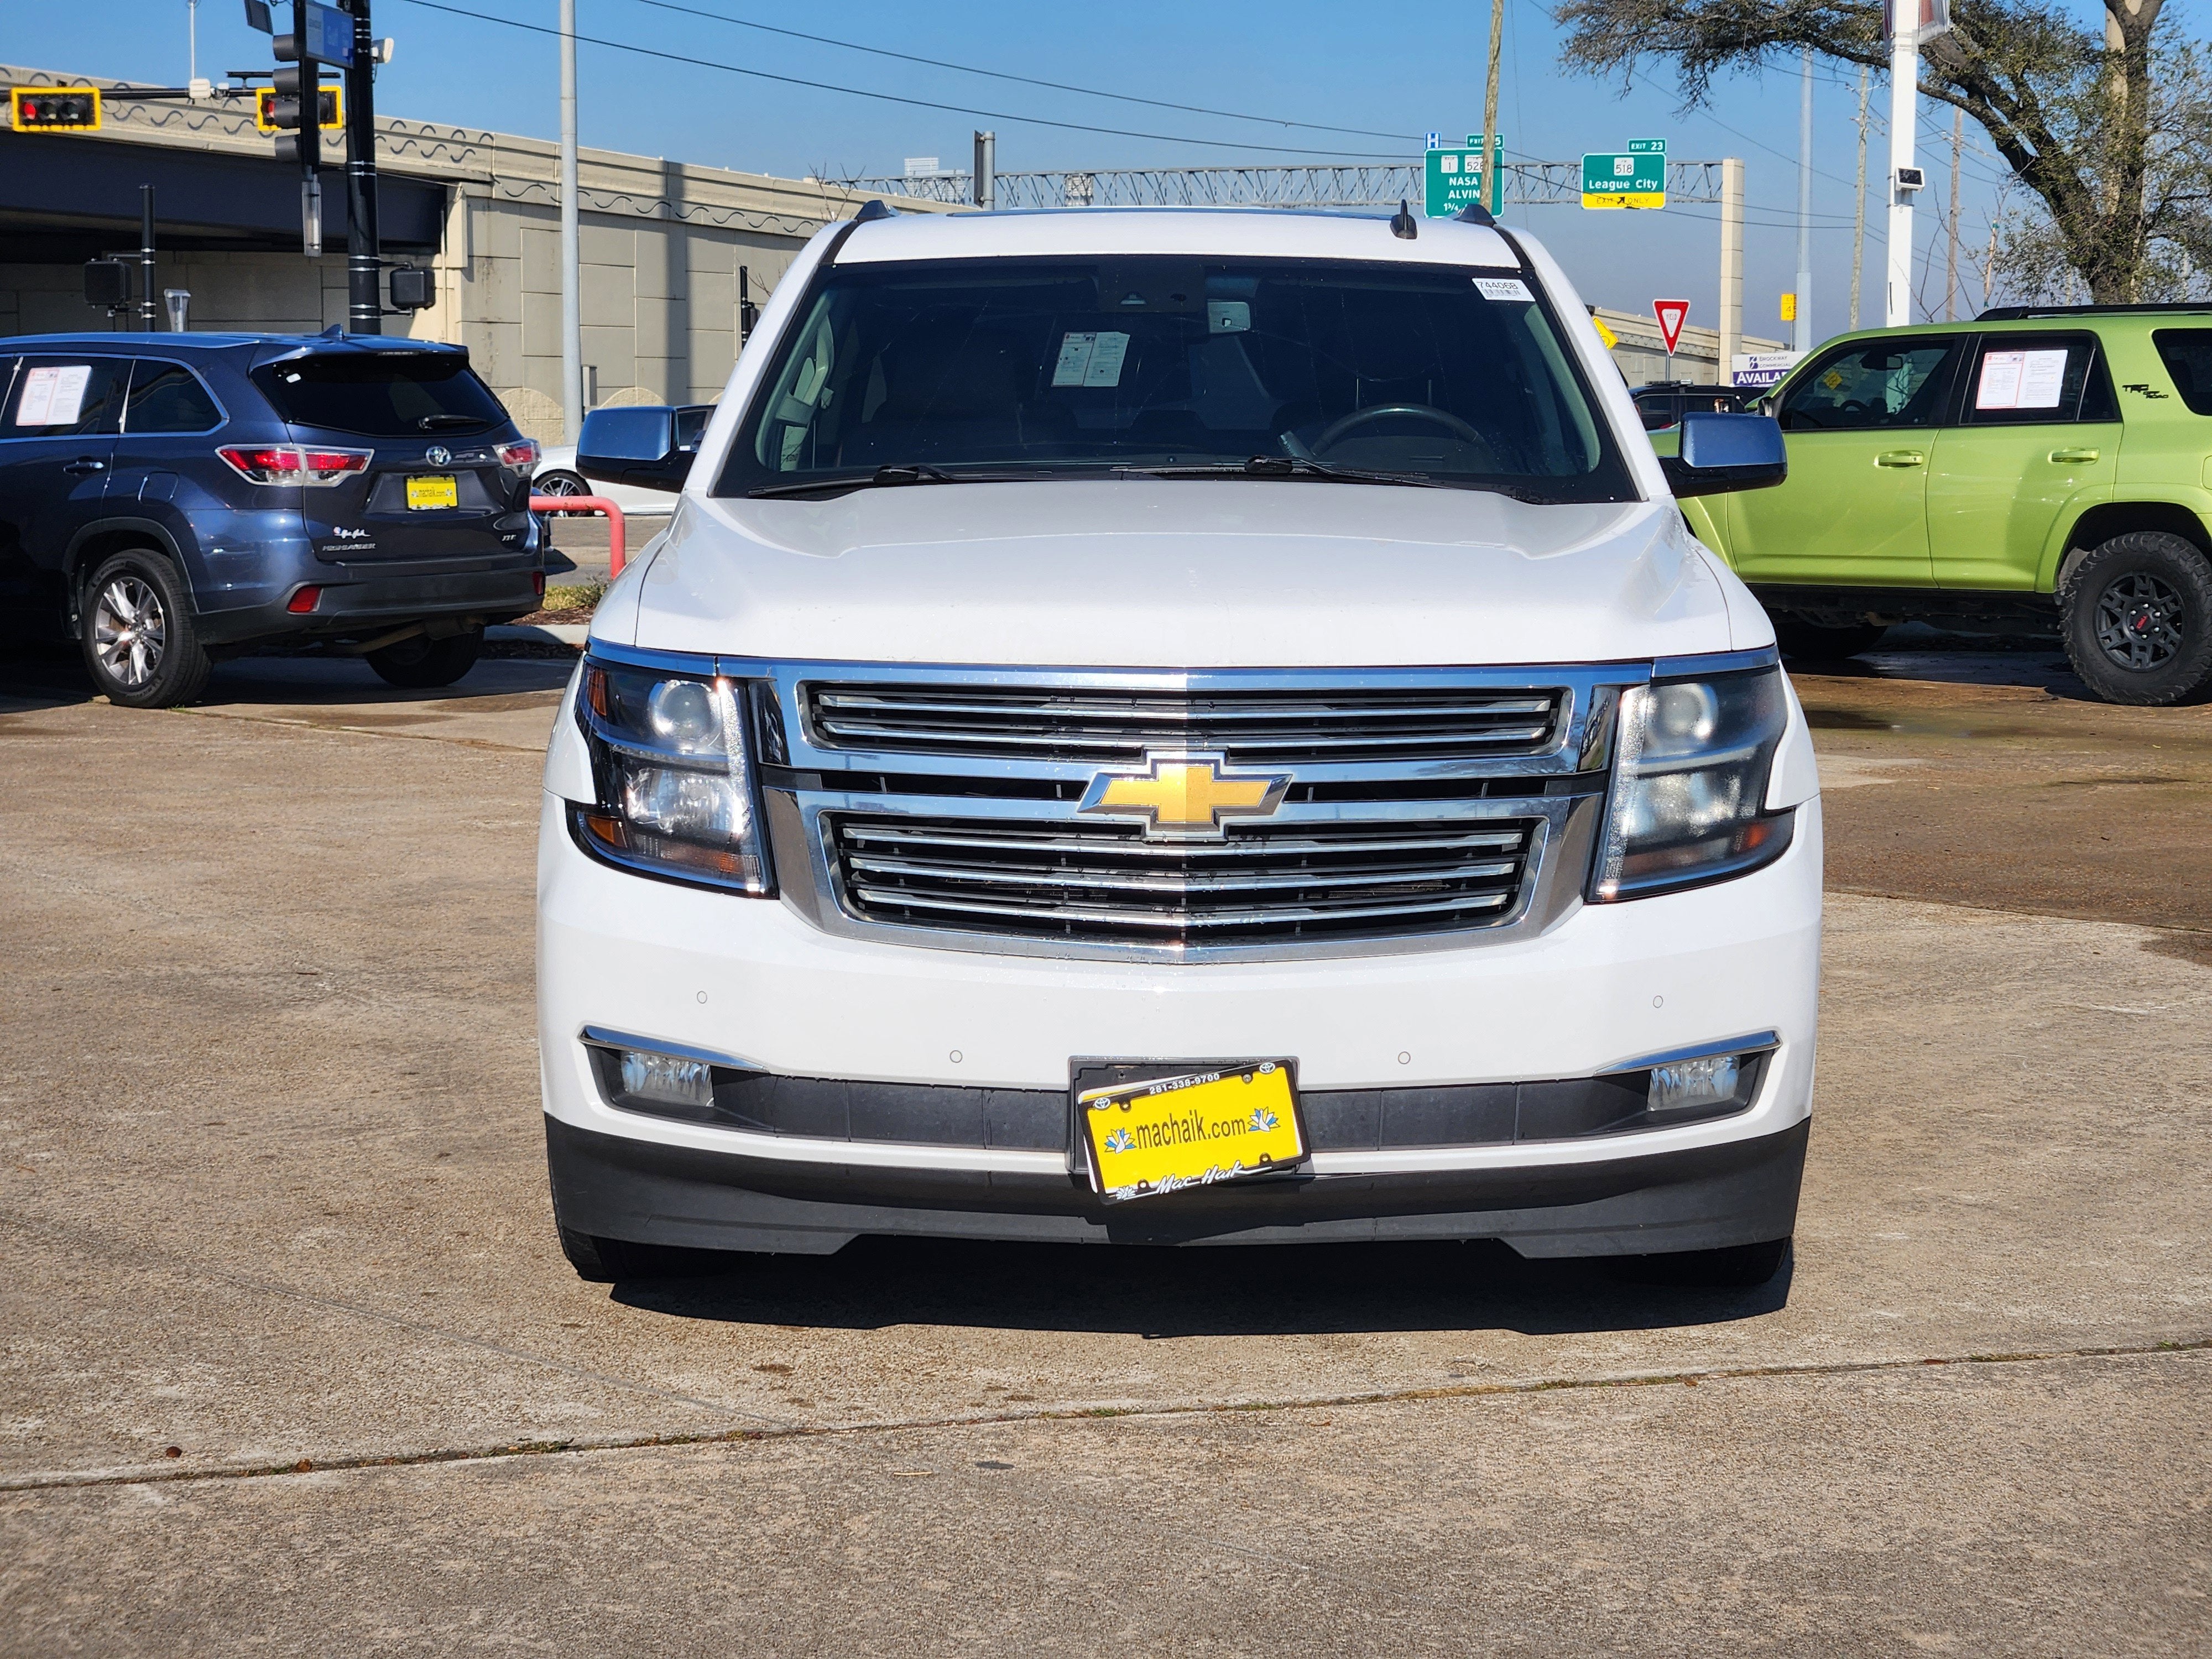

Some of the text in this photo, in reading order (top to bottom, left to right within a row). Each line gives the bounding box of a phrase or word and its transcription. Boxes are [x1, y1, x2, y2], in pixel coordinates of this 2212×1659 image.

[1651, 142, 1663, 150] 23
[1615, 164, 1632, 174] 518
[1449, 176, 1478, 186] NASA
[1589, 179, 1658, 191] League City
[1448, 190, 1480, 199] ALVIN
[1149, 1073, 1220, 1095] 281-338-9700
[1136, 1109, 1246, 1150] machaik.com
[1155, 1160, 1258, 1194] Mac Haik
